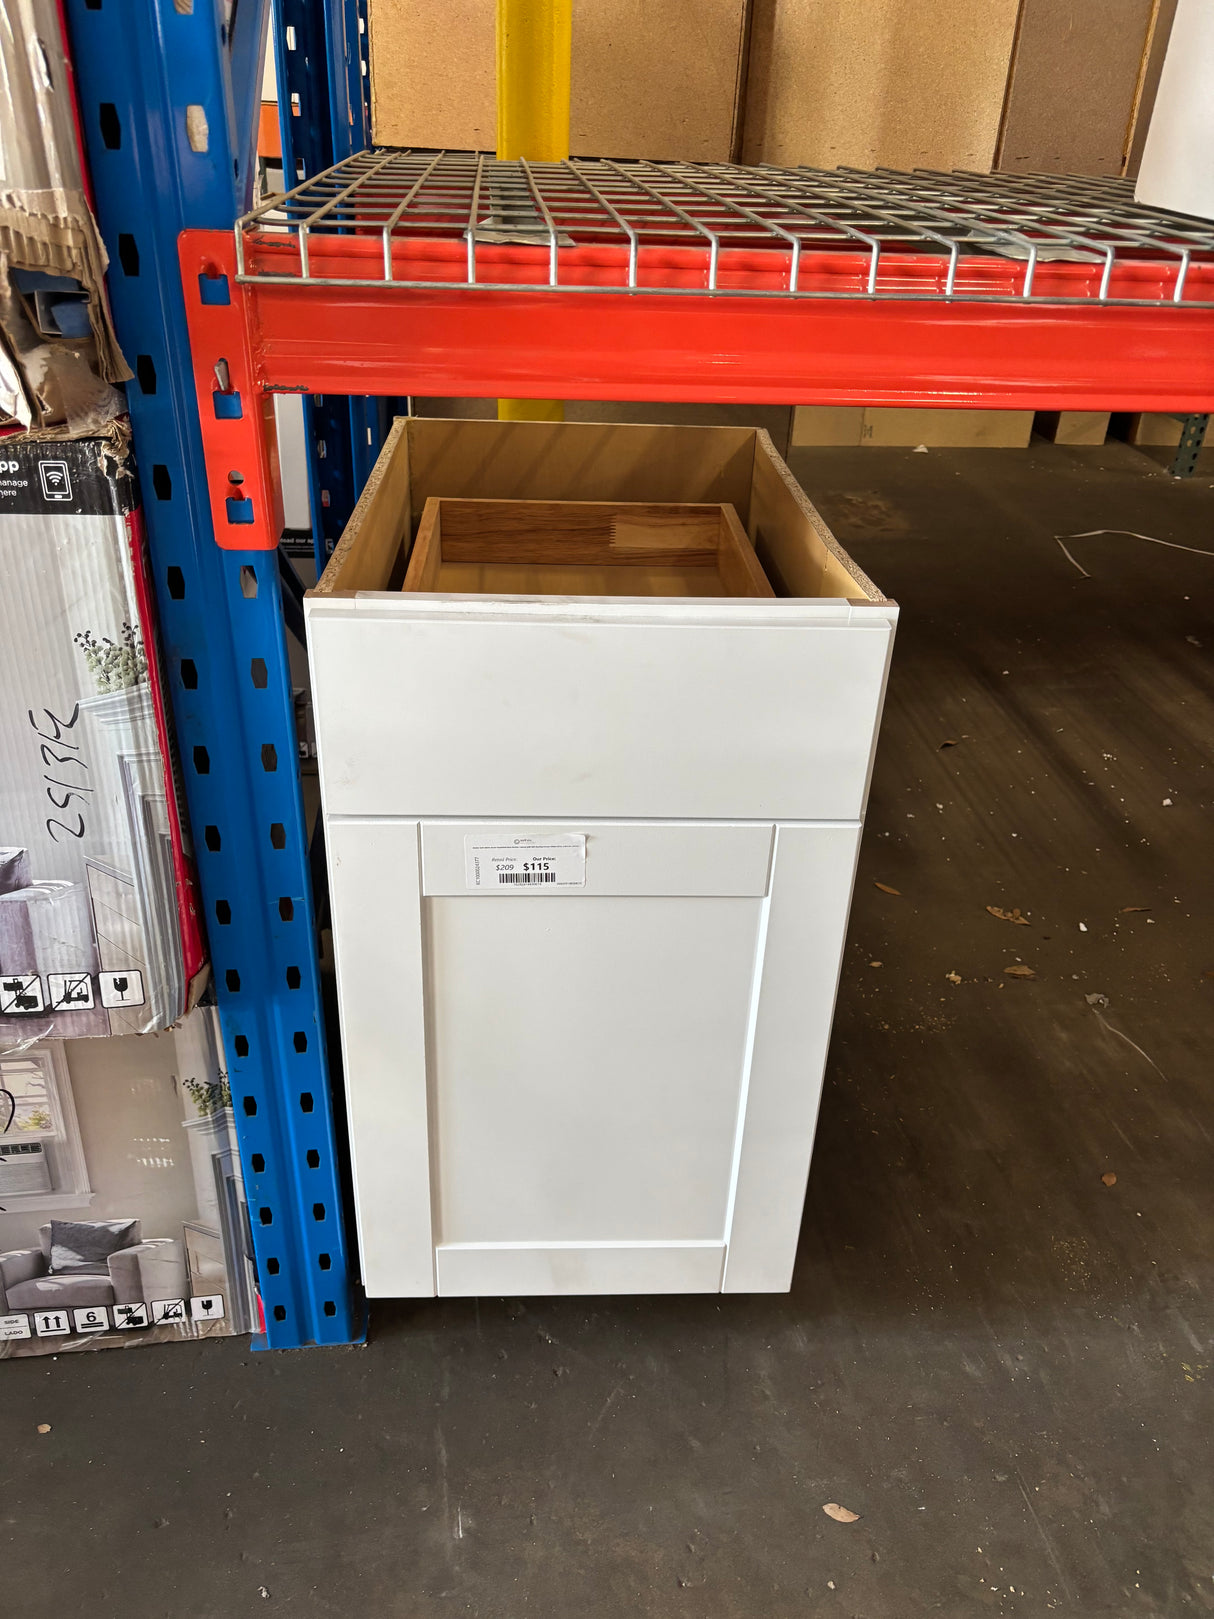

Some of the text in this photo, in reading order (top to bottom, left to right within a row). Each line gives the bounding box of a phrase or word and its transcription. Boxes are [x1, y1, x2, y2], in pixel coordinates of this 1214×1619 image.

[0, 460, 19, 474] pp
[523, 862, 550, 871] $115
[86, 1312, 96, 1322] 6
